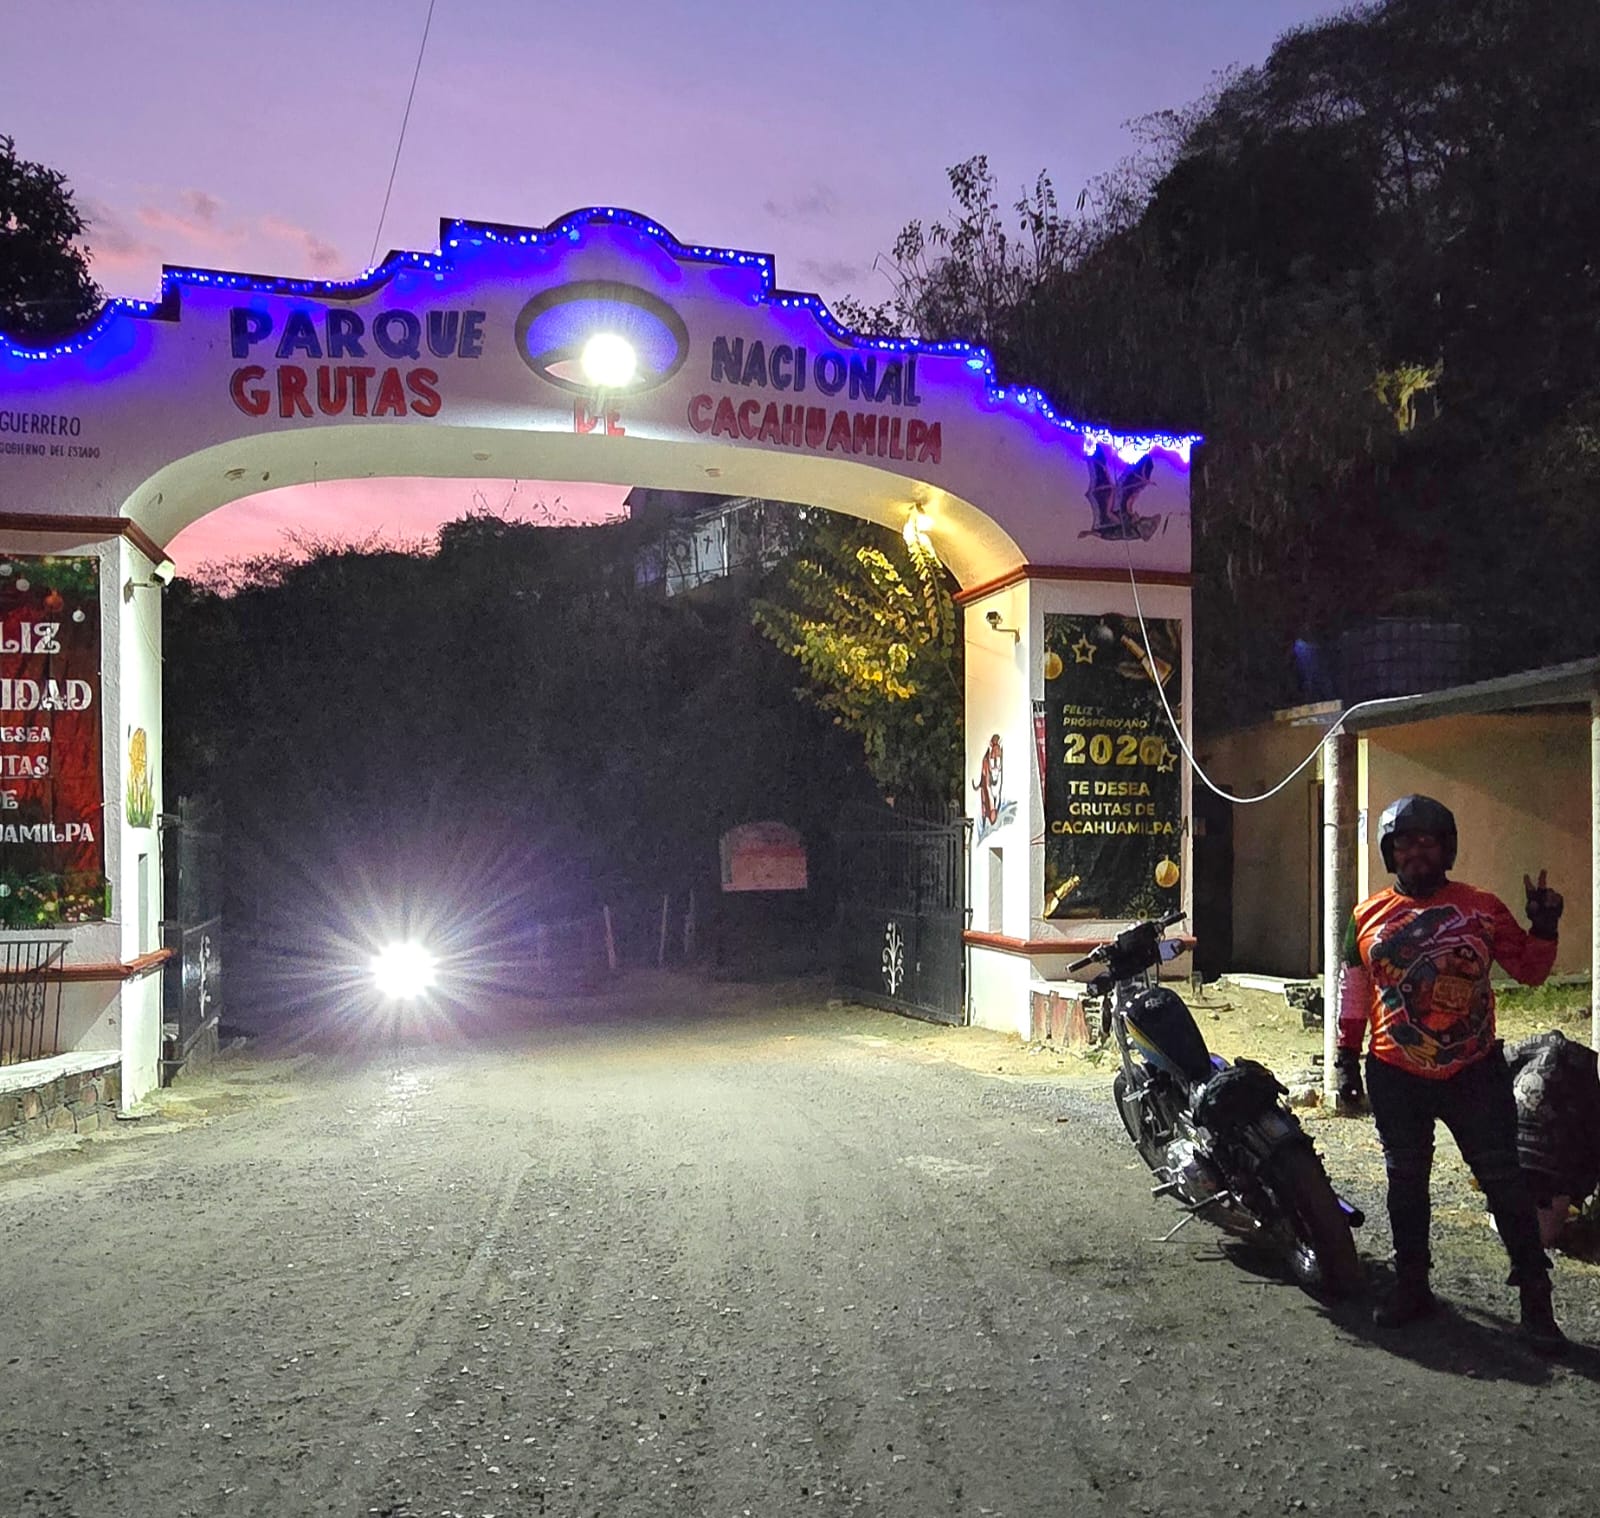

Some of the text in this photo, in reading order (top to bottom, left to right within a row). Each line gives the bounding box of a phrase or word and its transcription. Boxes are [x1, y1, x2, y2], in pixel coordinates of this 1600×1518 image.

[229, 306, 922, 406] PARQUE NACIONAL
[230, 364, 942, 464] GRUTAS DE CACAHUAMILPA
[0, 410, 81, 436] GUERRERO
[50, 445, 65, 457] DEL
[67, 446, 100, 459] ESTADO
[1062, 704, 1094, 716] FELIZ
[1068, 781, 1150, 796] TE DESEA
[1069, 802, 1156, 816] GRUTAS DE
[1051, 820, 1174, 836] CACAHUAMILPA
